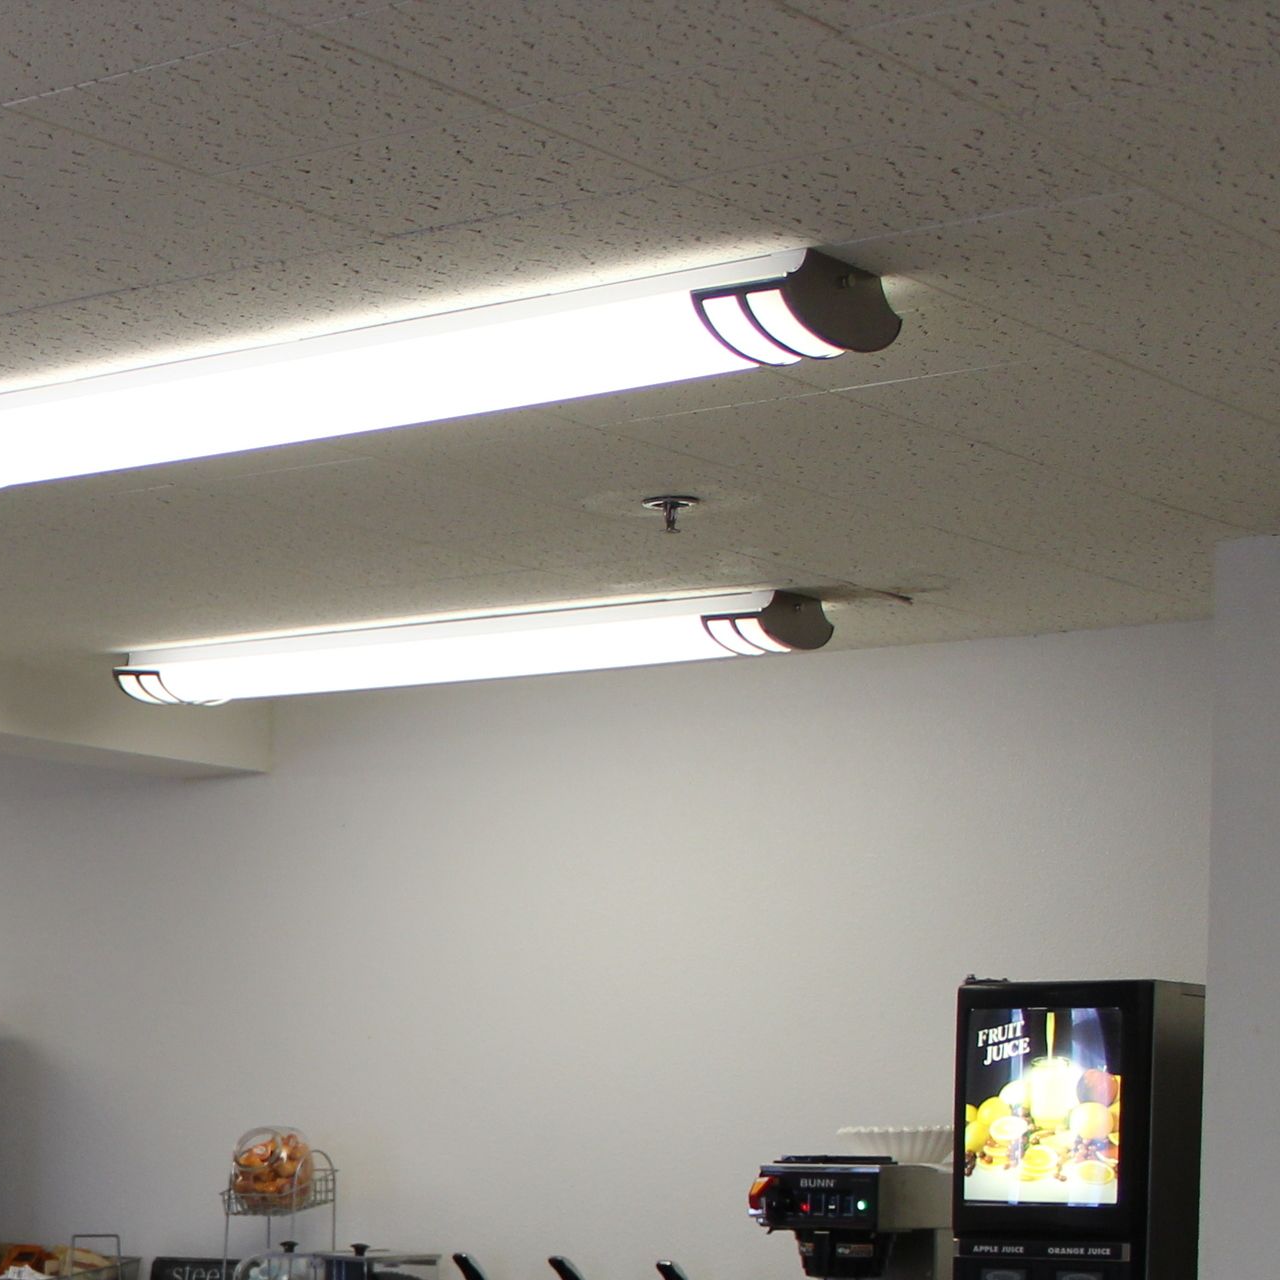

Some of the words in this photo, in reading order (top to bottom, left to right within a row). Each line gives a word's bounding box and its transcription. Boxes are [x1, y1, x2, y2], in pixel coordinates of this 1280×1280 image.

[977, 1020, 1025, 1047] FRUIT
[983, 1037, 1030, 1065] JUICE
[800, 1178, 835, 1188] BUNN
[972, 1245, 999, 1253] APPLE
[1001, 1246, 1025, 1254] JUICE
[1047, 1247, 1085, 1255] ORANGE
[1087, 1248, 1111, 1256] JUICE
